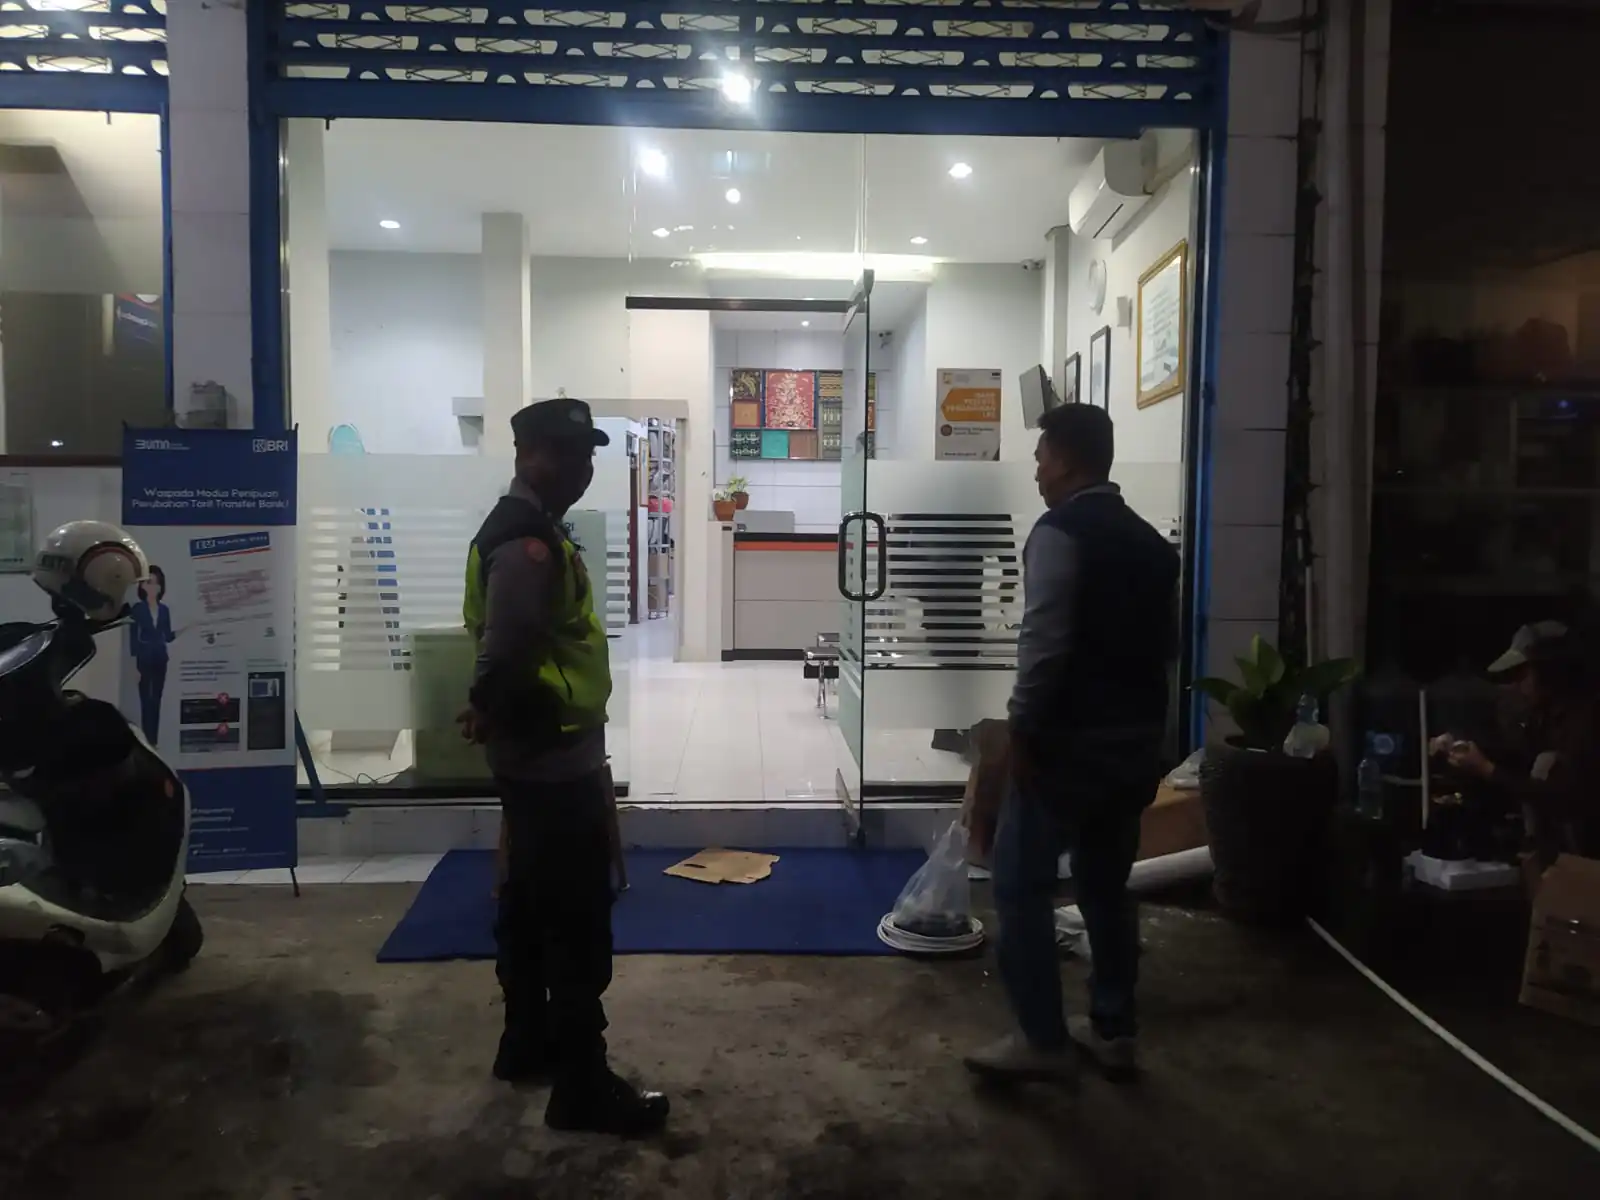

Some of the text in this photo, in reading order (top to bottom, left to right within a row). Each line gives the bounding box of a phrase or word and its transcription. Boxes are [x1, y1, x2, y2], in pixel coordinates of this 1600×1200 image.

[266, 440, 289, 452] BRI
[143, 488, 279, 499] Waspada Modus Penipuan
[132, 499, 190, 509] Perubahan
[191, 499, 214, 508] Tarif
[216, 499, 256, 508] Transfer
